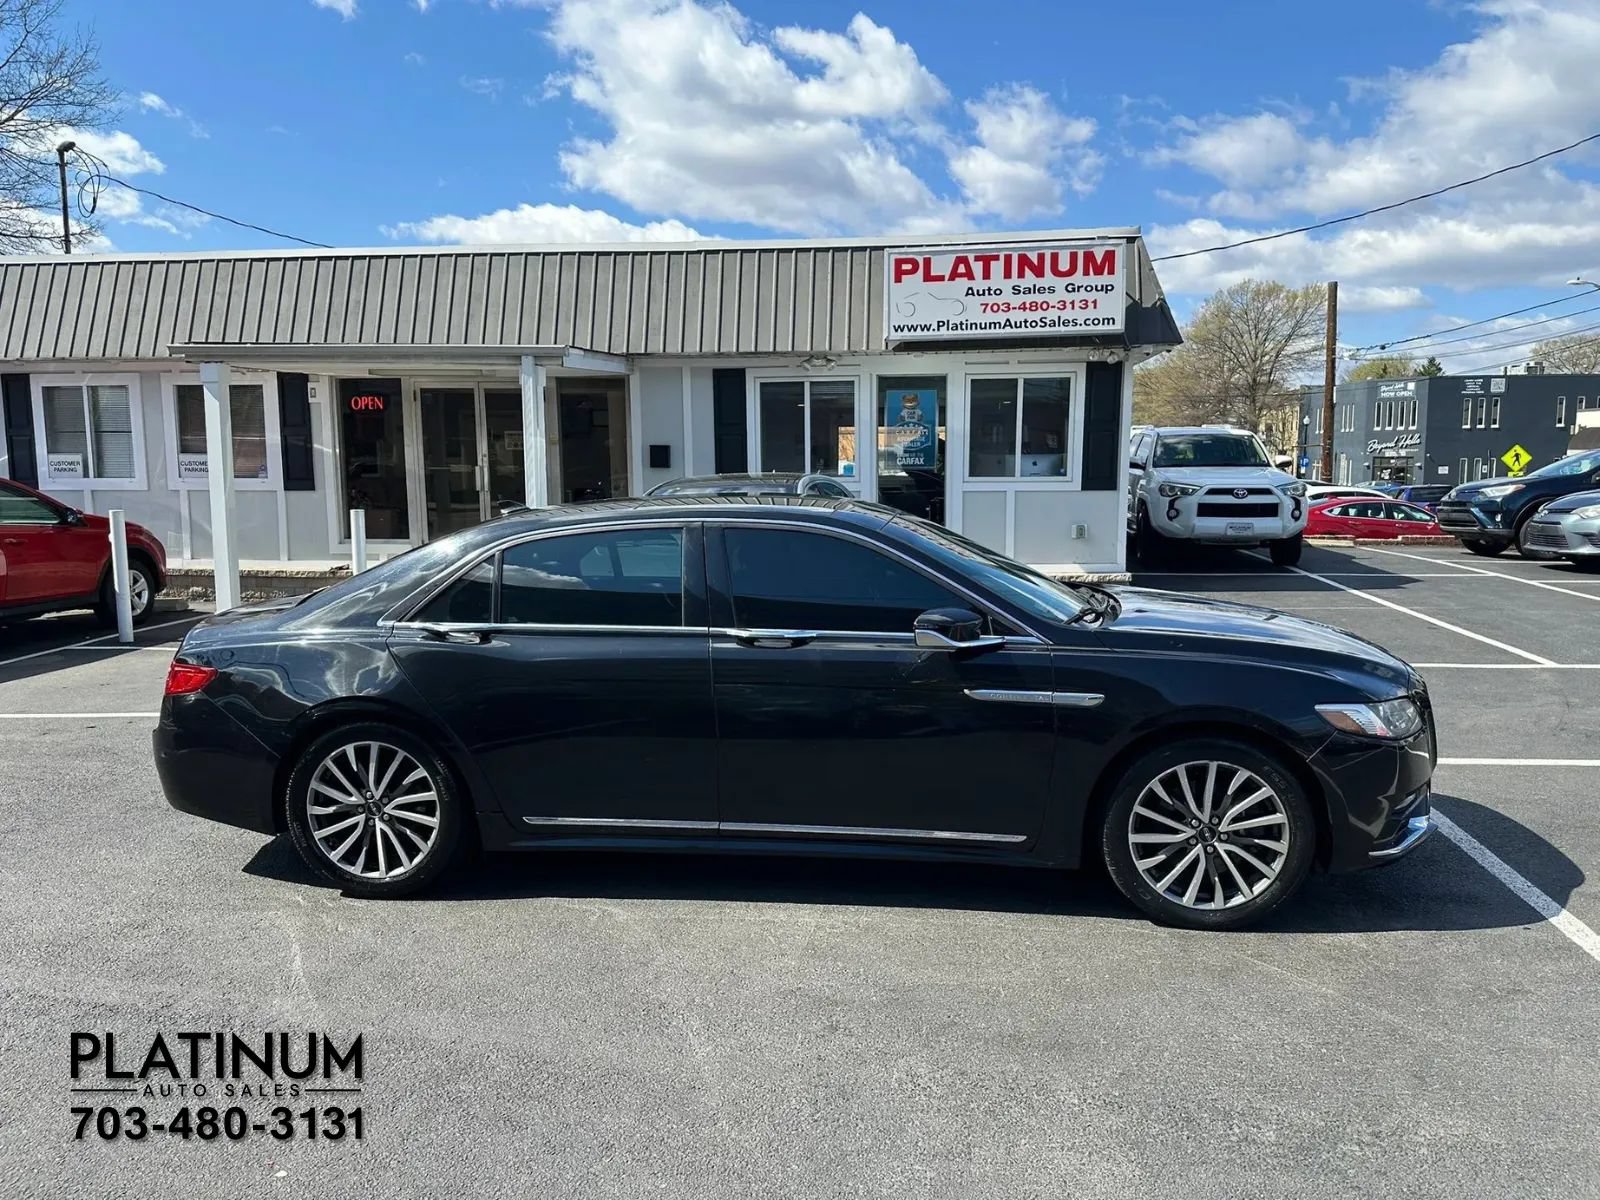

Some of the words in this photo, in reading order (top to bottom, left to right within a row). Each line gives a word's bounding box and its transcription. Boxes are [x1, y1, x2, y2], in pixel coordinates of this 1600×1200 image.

[893, 250, 1116, 283] PLATINUM
[964, 286, 1003, 297] Auto
[1011, 284, 1056, 295] Sales
[1064, 282, 1115, 295] Group
[979, 299, 1098, 313] 703-480-3131
[892, 316, 1116, 334] www.PlatinumAutoSales.com
[351, 396, 383, 410] OPEN
[897, 457, 925, 465] CARFAX
